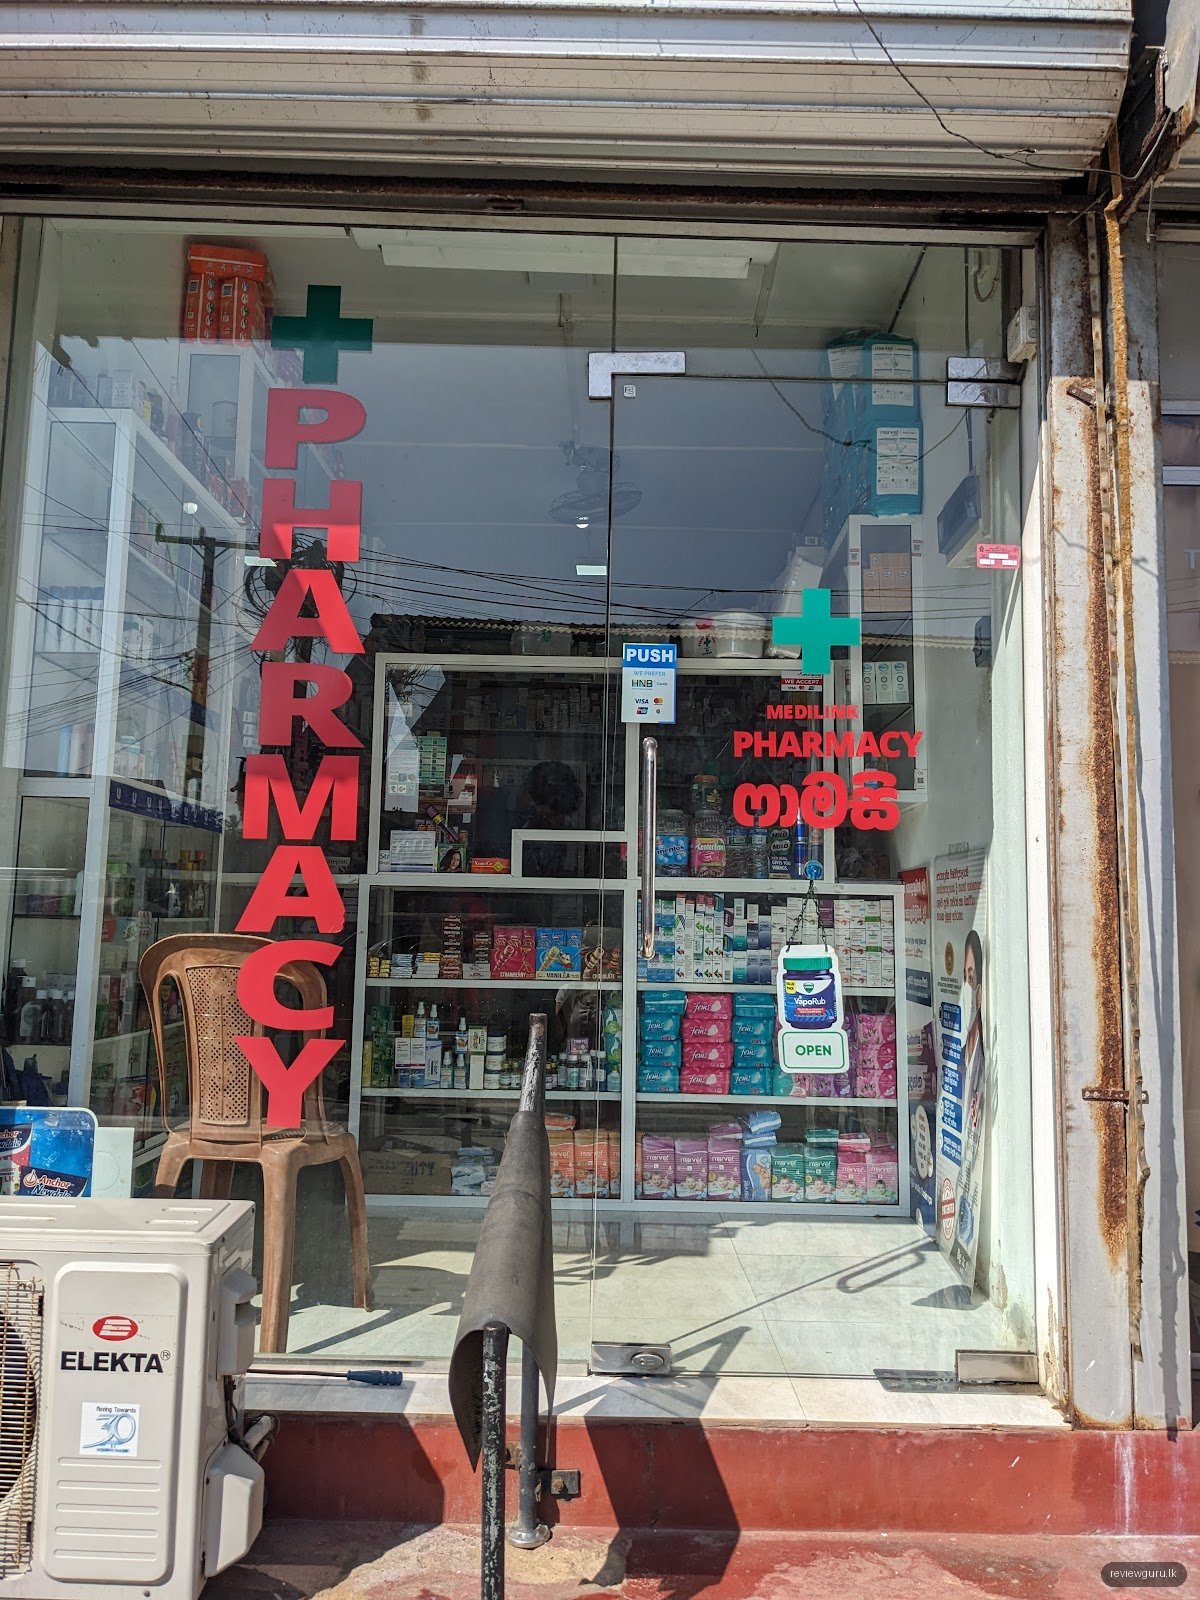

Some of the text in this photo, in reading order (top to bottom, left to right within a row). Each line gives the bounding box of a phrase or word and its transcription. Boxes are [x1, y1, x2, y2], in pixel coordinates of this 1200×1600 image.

[626, 648, 674, 663] PUSH
[631, 679, 653, 688] HNB
[766, 704, 859, 720] MEDILINK
[733, 731, 924, 758] PHARMACY
[233, 388, 366, 1129] PHARMACY
[794, 996, 826, 1007] VapoRub
[795, 1045, 832, 1056] OPEN
[680, 1156, 703, 1164] marvel
[712, 1155, 735, 1163] marvel
[38, 1174, 72, 1189] Anchor
